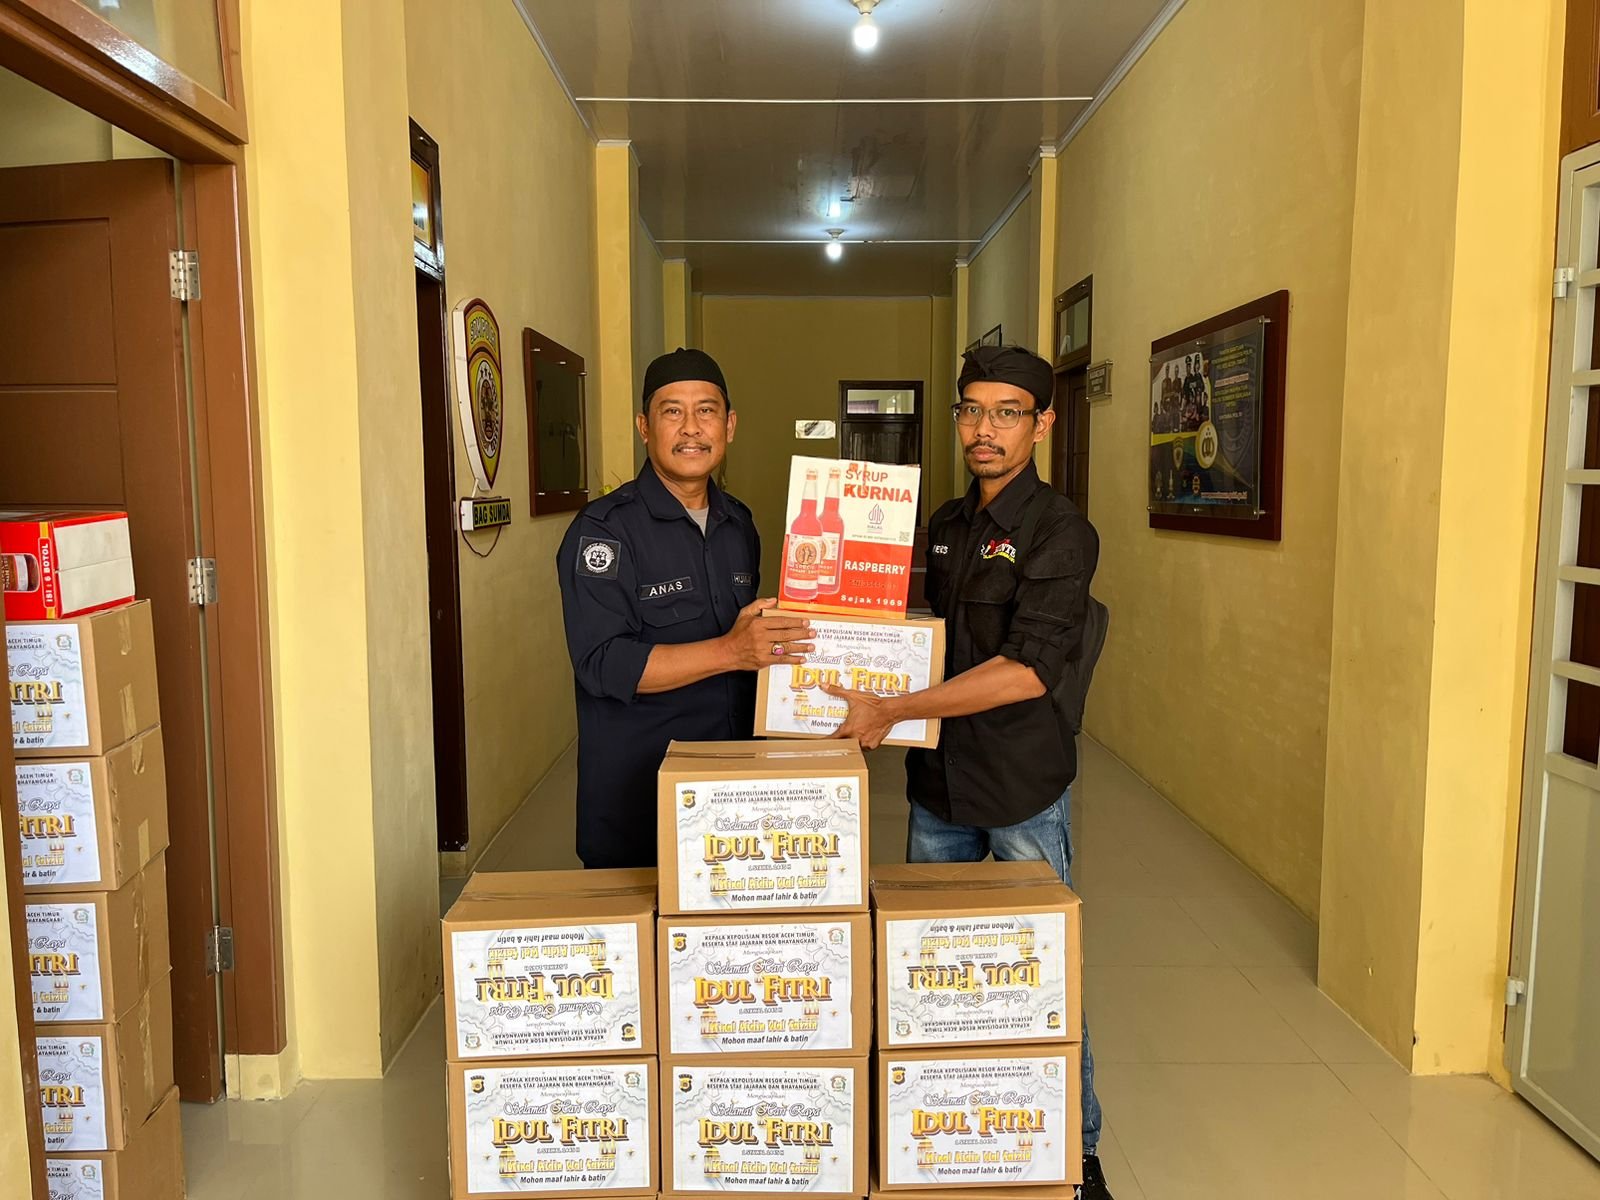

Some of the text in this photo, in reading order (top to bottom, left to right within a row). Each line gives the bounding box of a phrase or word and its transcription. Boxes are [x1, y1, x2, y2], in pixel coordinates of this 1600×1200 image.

[845, 469, 888, 483] SYRUP
[843, 483, 913, 503] KURNIA
[473, 505, 488, 525] BAG
[41, 543, 51, 574] BOTOL
[844, 560, 906, 575] RASPBERRY
[45, 590, 53, 602] ISI
[649, 581, 683, 597] ANAS
[840, 594, 903, 607] Sejak 1969
[789, 664, 912, 696] IDUL FITRI
[11, 682, 64, 705] ITRI
[810, 720, 832, 728] Mohon
[26, 735, 44, 743] batin
[21, 814, 76, 839] ITRI
[714, 814, 828, 833] Selamat Hari Raya
[703, 829, 841, 865] IDUL FITRI
[31, 869, 56, 878] & batin
[731, 891, 818, 902] Mohon maaf lahir & batin
[930, 926, 947, 934] batin
[956, 924, 971, 932] lahir
[972, 923, 990, 931] maaf
[992, 922, 1014, 930] Mohon
[497, 936, 515, 944] batin
[524, 935, 540, 943] lahir
[540, 934, 560, 942] maaf
[561, 933, 584, 941] Mohon
[29, 953, 81, 976] ITRI
[705, 957, 820, 977] Selamat Hari Raya
[907, 957, 1041, 994] IDUL FITRI
[474, 968, 614, 1006] IDUL FITRI
[694, 973, 832, 1008] IDUL FITRI
[722, 1037, 745, 1045] Mohon
[747, 1036, 765, 1044] maaf
[766, 1035, 782, 1043] lahir
[791, 1034, 808, 1042] batin
[923, 1090, 1034, 1109] Selamat Hari Raya
[503, 1099, 616, 1118] Selamat Hari Raya
[710, 1102, 822, 1121] Selamat Hari Raya
[911, 1105, 1046, 1139] IDUL FITRI
[492, 1114, 629, 1148] IDUL FITRI
[698, 1118, 834, 1148] IDUL FITRI
[47, 1136, 65, 1144] batin
[938, 1167, 960, 1175] Mohon
[981, 1166, 996, 1174] lahir
[1005, 1165, 1022, 1173] batin
[520, 1176, 543, 1184] Mohon
[545, 1175, 563, 1183] maaf
[581, 1174, 587, 1182] &
[768, 1177, 783, 1185] lahir
